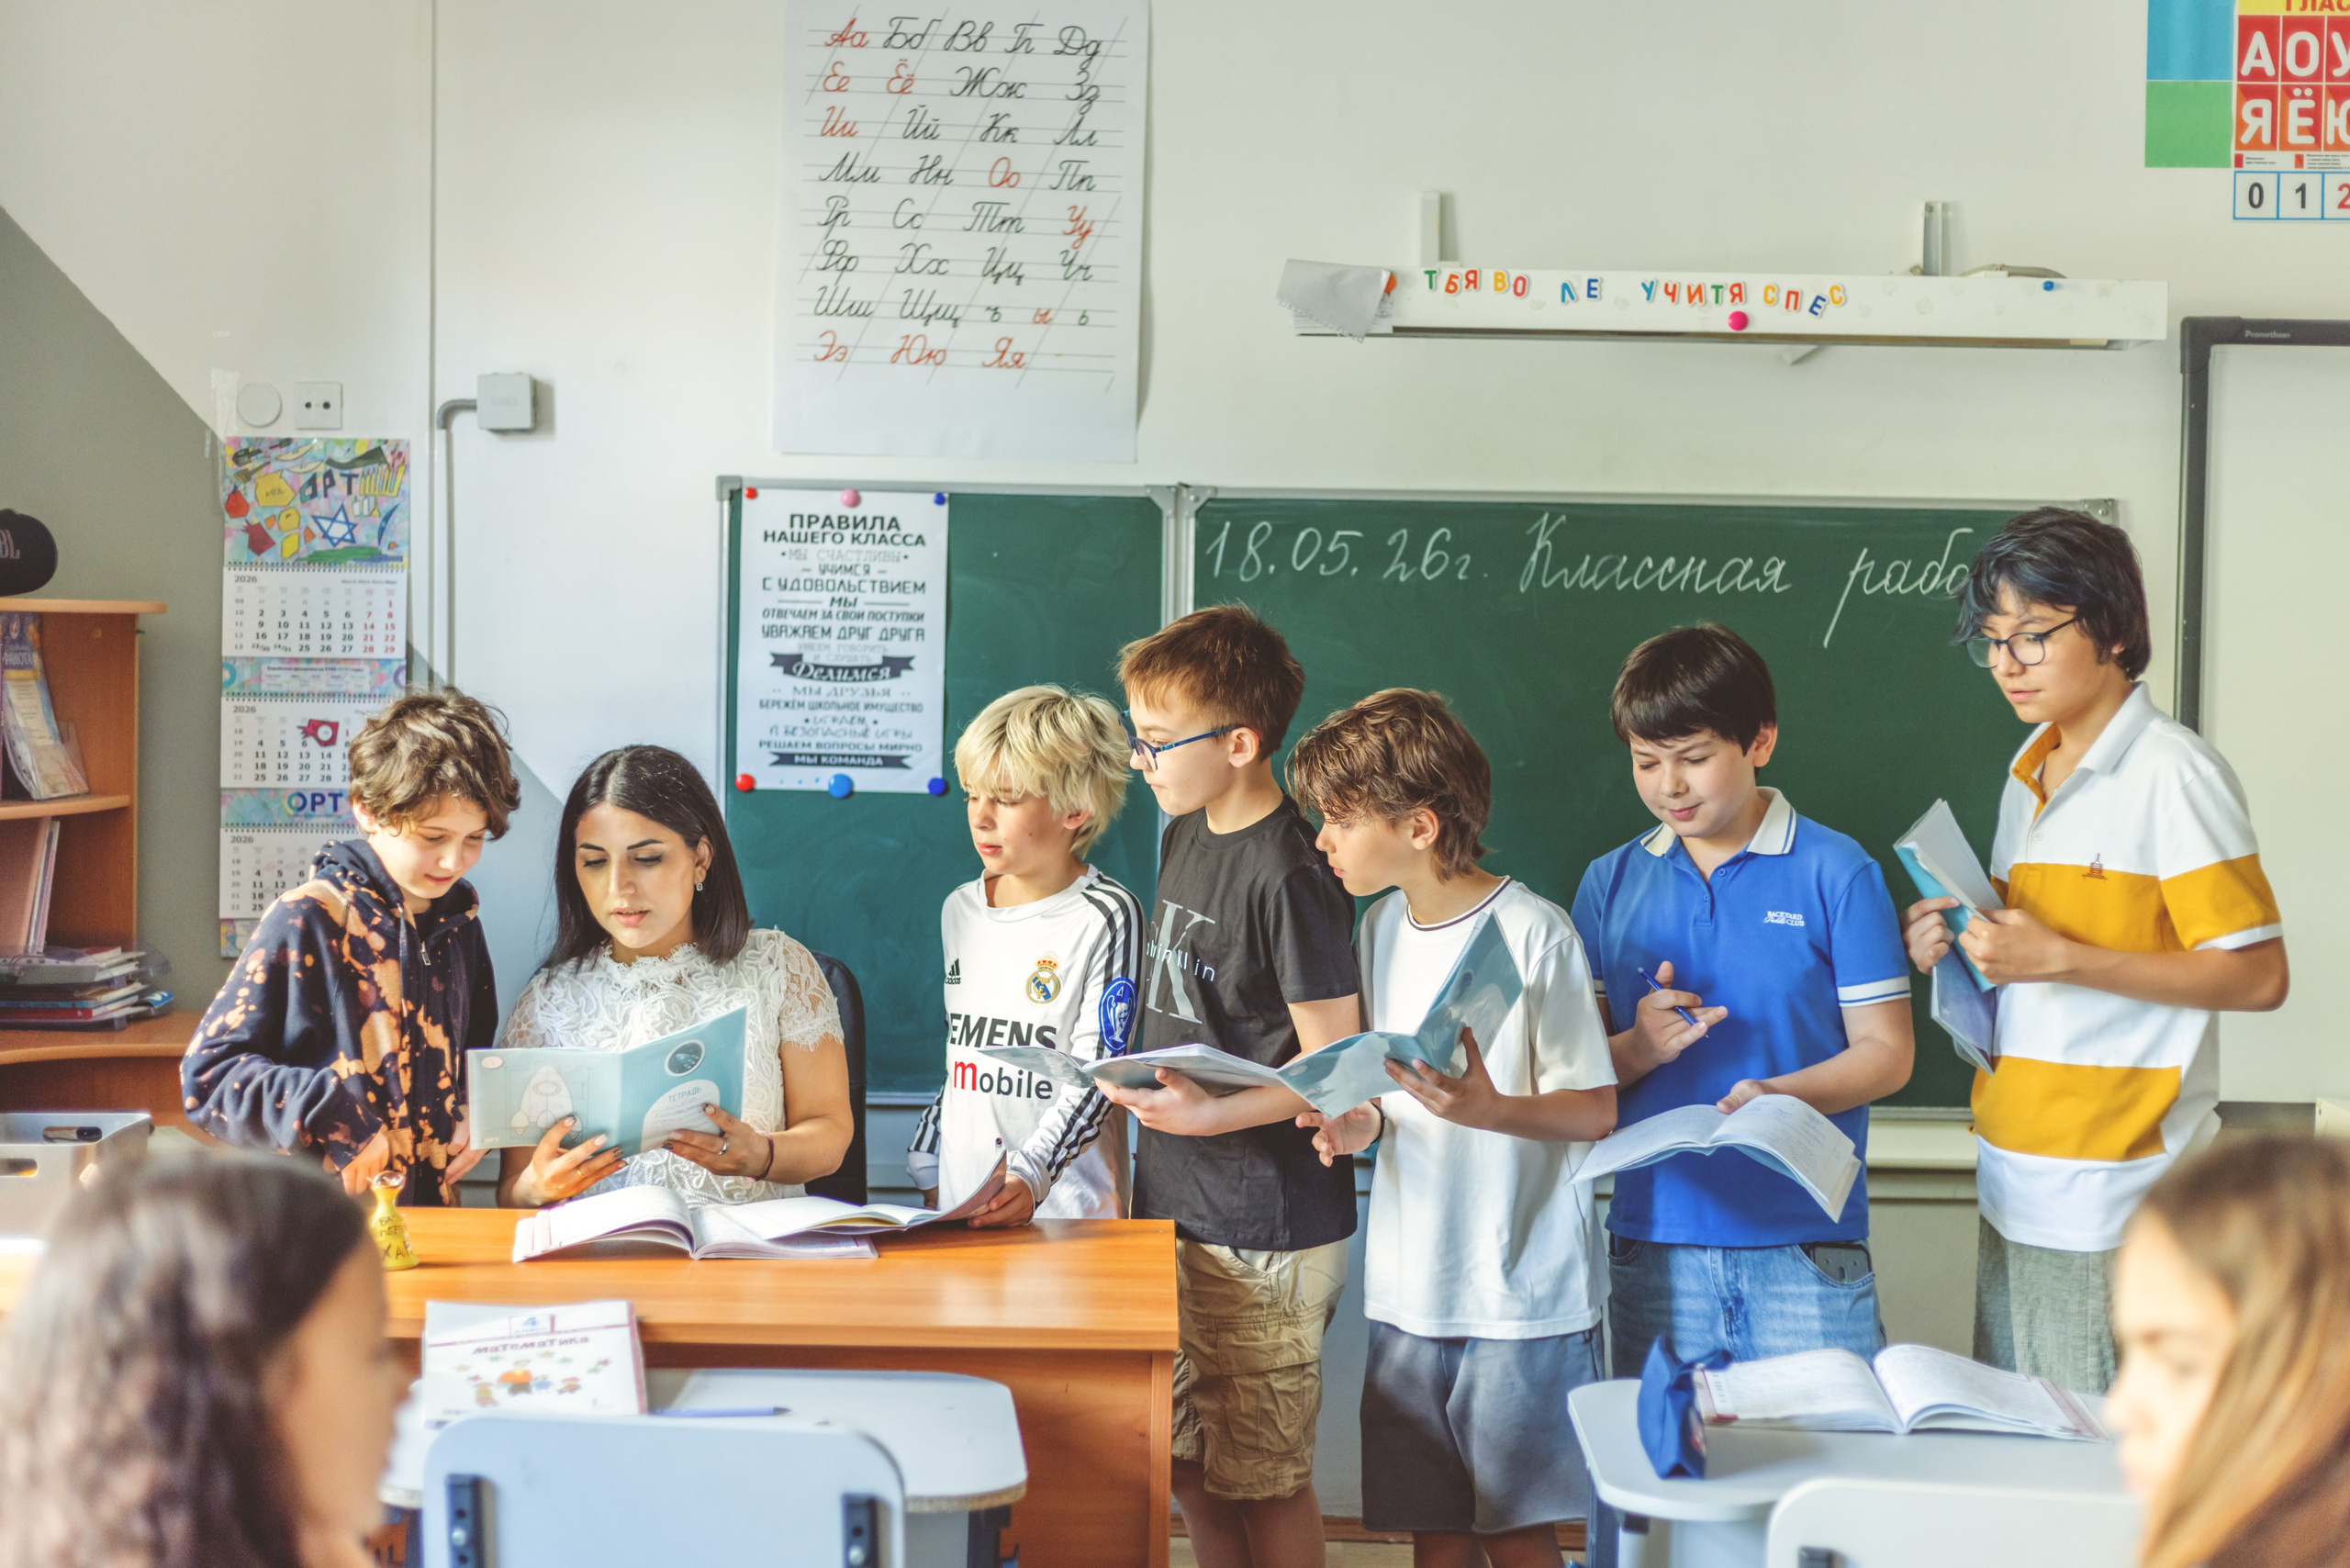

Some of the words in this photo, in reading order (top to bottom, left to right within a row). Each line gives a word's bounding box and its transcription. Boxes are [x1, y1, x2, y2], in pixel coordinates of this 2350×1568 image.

[824, 17, 870, 48] Аа
[882, 17, 943, 50] Бб
[944, 20, 994, 52] Вв
[1053, 26, 1102, 70] Дд
[822, 62, 851, 93] Ее
[887, 59, 915, 95] Ёё
[949, 67, 1028, 99] Жж
[1065, 71, 1101, 114] Зз
[820, 106, 858, 138] Ии
[902, 105, 941, 140] Йй
[979, 113, 1019, 143] Кк
[1053, 116, 1098, 146] Лл
[819, 151, 881, 184] Мм
[909, 155, 954, 185] Нн
[988, 157, 1021, 188] Оо
[1049, 161, 1097, 192] Пп
[2248, 182, 2264, 209] 0
[2295, 183, 2306, 209] 1
[817, 196, 852, 238] Рр
[892, 198, 923, 230] Сс
[962, 201, 1026, 233] Тт
[1061, 206, 1094, 249] Уу
[816, 240, 859, 285] Фф
[894, 243, 951, 275] Хх
[981, 247, 1026, 285] Цц
[1059, 250, 1092, 282] Чч
[813, 286, 873, 318] Шш
[899, 288, 962, 328] Щщ
[985, 306, 1001, 322] ъ
[1033, 308, 1053, 325] ы
[1078, 309, 1090, 326] ь
[2245, 330, 2290, 338] Promethean
[813, 330, 848, 362] Ээ
[890, 334, 947, 366] Юю
[981, 337, 1026, 368] Яя
[789, 514, 901, 531] ПРАВИЛА
[0, 529, 20, 559] BL
[764, 531, 844, 544] НАШЕГО
[851, 532, 926, 546] КЛАССА
[818, 564, 870, 576] УЧИМСЯ
[763, 577, 772, 590] С
[778, 577, 926, 594] УДОВОЛЬСТВИЕМ
[1519, 511, 1793, 594] Классная
[1824, 528, 1974, 648] рабо
[388, 599, 393, 609] 1
[829, 597, 857, 608] МЫ
[258, 609, 264, 617] 2
[280, 609, 286, 618] 3
[301, 610, 308, 618] 4
[323, 610, 330, 619] 5
[344, 610, 352, 619] 6
[366, 610, 373, 619] 7
[762, 608, 818, 619] ОТВЕЧАЕМ
[821, 610, 834, 620] ЗА
[867, 611, 924, 622] ПОСТУПКИ
[257, 620, 265, 629] 9
[278, 621, 289, 629] 10
[299, 622, 310, 630] 11
[320, 622, 332, 630] 12
[342, 622, 353, 631] 13
[364, 622, 375, 631] 14
[385, 622, 396, 631] 15
[762, 624, 832, 639] УВАЖАЕМ
[836, 626, 873, 640] ДРУГ
[878, 627, 925, 642] ДРУГА
[255, 632, 267, 640] 16
[299, 633, 311, 641] 18
[320, 633, 332, 642] 19
[341, 633, 353, 642] 20
[384, 634, 396, 643] 22
[298, 644, 311, 653] 25
[319, 644, 332, 653] 26
[341, 644, 353, 653] 27
[384, 645, 396, 654] 29
[792, 662, 891, 681] Делимся
[257, 739, 264, 747] 4
[279, 739, 286, 748] 5
[301, 740, 308, 748] 6
[759, 740, 811, 749] РЕШАЕМ
[815, 742, 875, 751] ВОПРОСЫ
[878, 743, 923, 753] МИРНО
[255, 750, 266, 759] 11
[277, 751, 289, 759] 12
[299, 751, 311, 759] 13
[794, 755, 818, 765] МЫ
[821, 756, 884, 767] КОМАНДА
[255, 762, 267, 770] 18
[277, 762, 289, 770] 19
[298, 763, 311, 771] 20
[320, 763, 331, 771] 21
[254, 773, 267, 781] 25
[276, 774, 289, 782] 26
[298, 774, 310, 782] 27
[320, 774, 332, 782] 28
[1767, 911, 1803, 920] BACKYARD
[1785, 919, 1805, 927] CLUB
[1147, 940, 1172, 964] lvin
[1147, 899, 1215, 1025] K
[950, 1013, 1057, 1049] EMENS
[954, 1060, 1053, 1100] mobile
[668, 1087, 701, 1102] ТЕТРАДЬ
